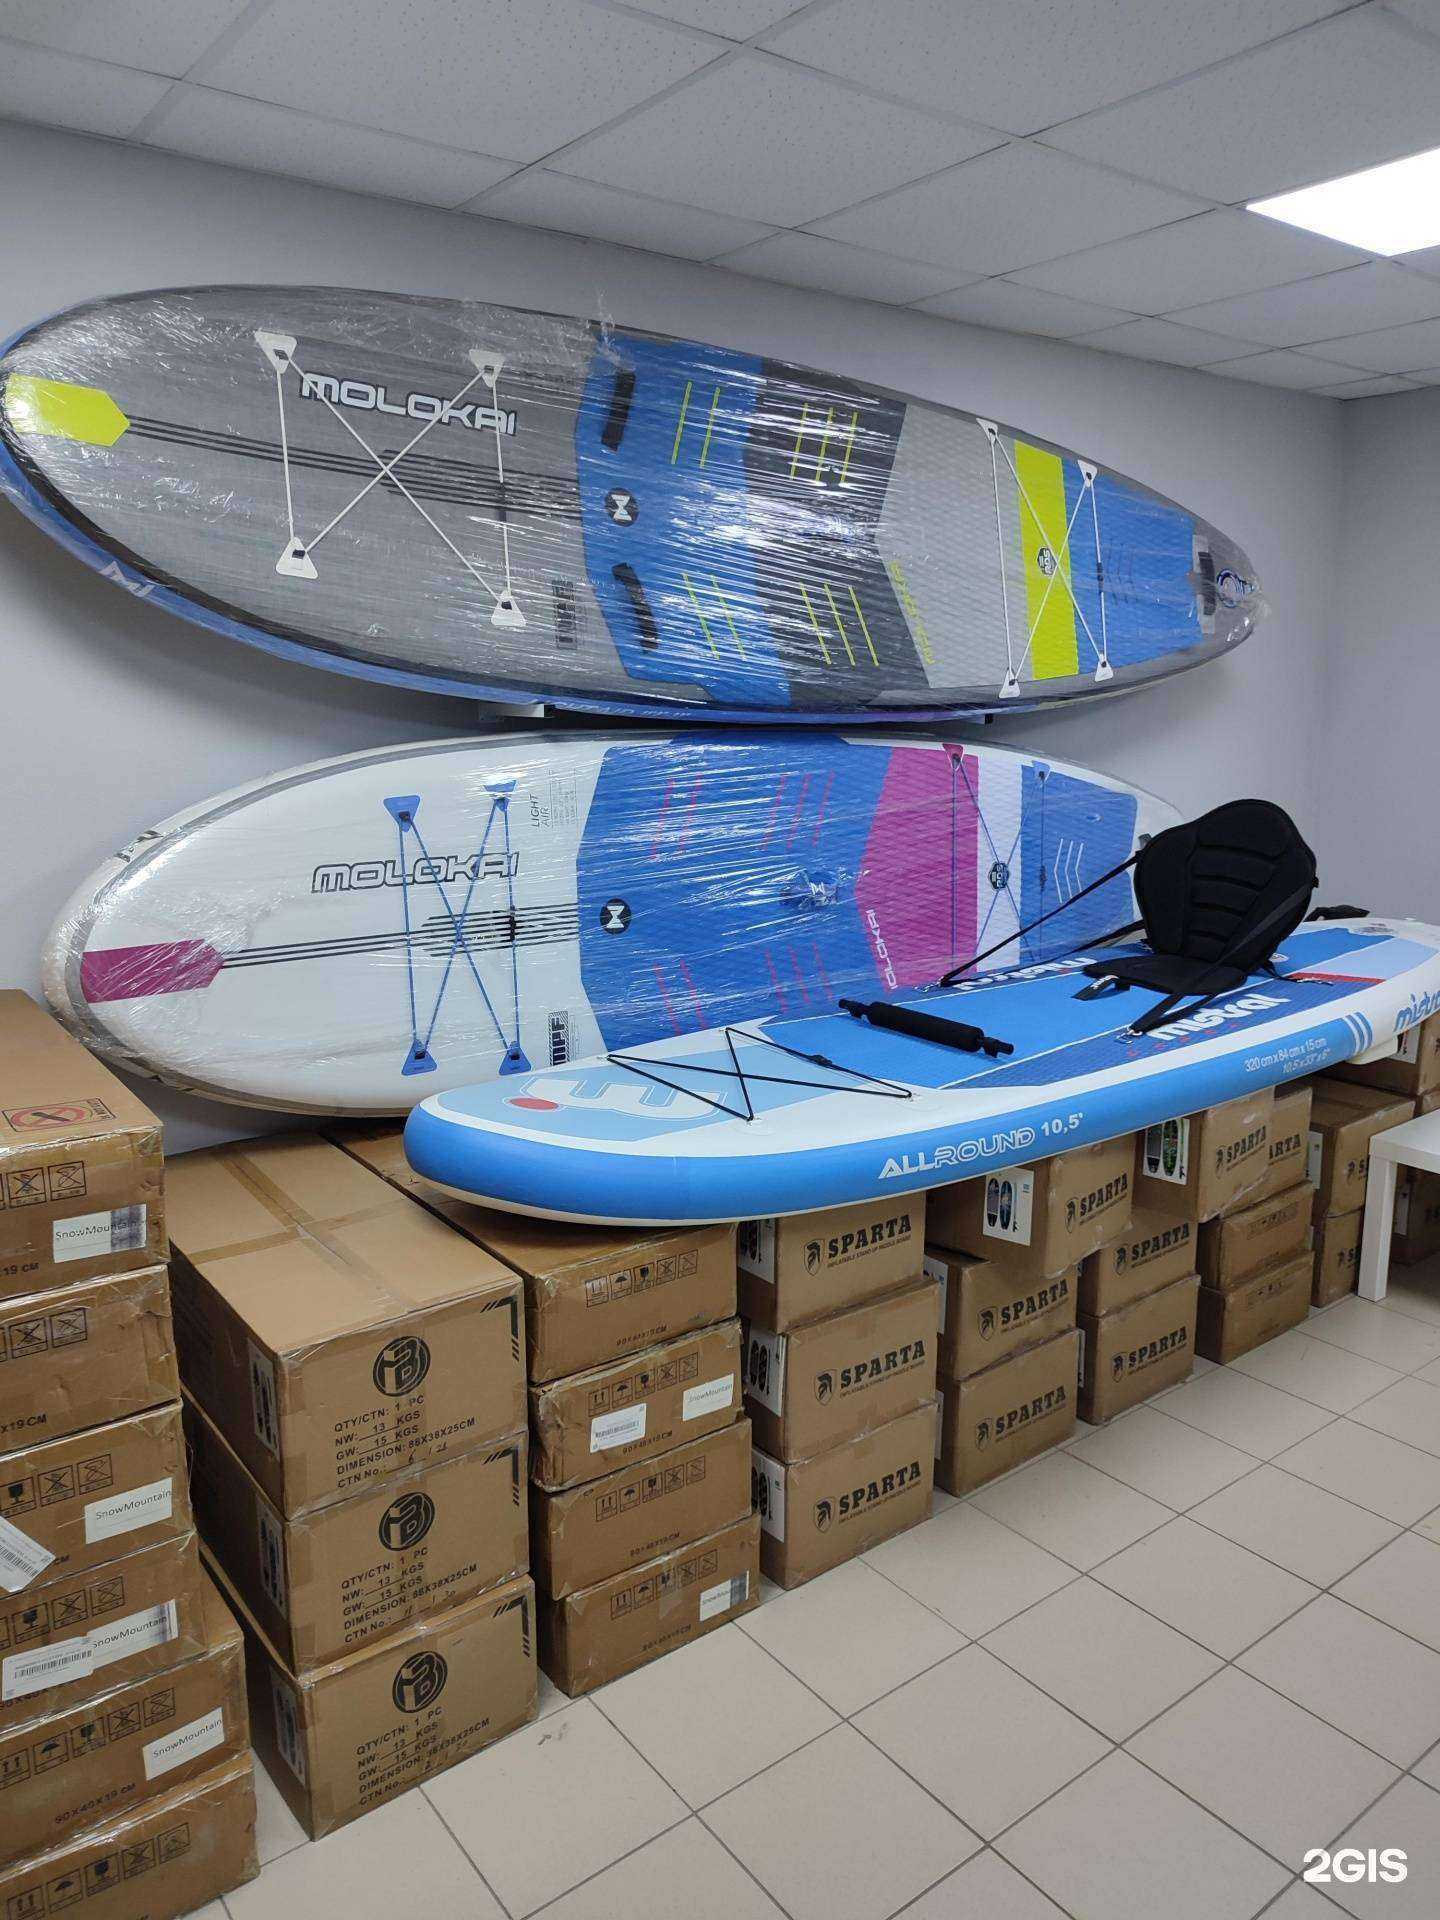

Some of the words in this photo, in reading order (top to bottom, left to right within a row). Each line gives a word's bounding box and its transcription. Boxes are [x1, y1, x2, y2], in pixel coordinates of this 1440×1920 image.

[300, 371, 517, 436] MOLOKAI
[529, 793, 540, 828] LIGHT
[311, 850, 519, 893] MOLOKAI
[878, 1126, 1036, 1179] ALLROUND
[1226, 1125, 1266, 1163] SPARTA
[1079, 1172, 1128, 1218] SPARTA
[828, 1214, 912, 1259] SPARTA
[1131, 1222, 1190, 1262] SPARTA
[1001, 1279, 1069, 1325] SPARTA
[840, 1339, 926, 1390] SPARTA
[1128, 1325, 1187, 1370] SPARTA
[397, 1410, 420, 1425] KGS
[995, 1385, 1067, 1436] SPARTA
[338, 1474, 361, 1488] CTN
[839, 1461, 921, 1516] SPARTA
[95, 1489, 173, 1521] SnowMountain
[401, 1562, 424, 1577] KGS
[344, 1626, 368, 1643] CTN
[152, 1719, 223, 1759] SnowMountain
